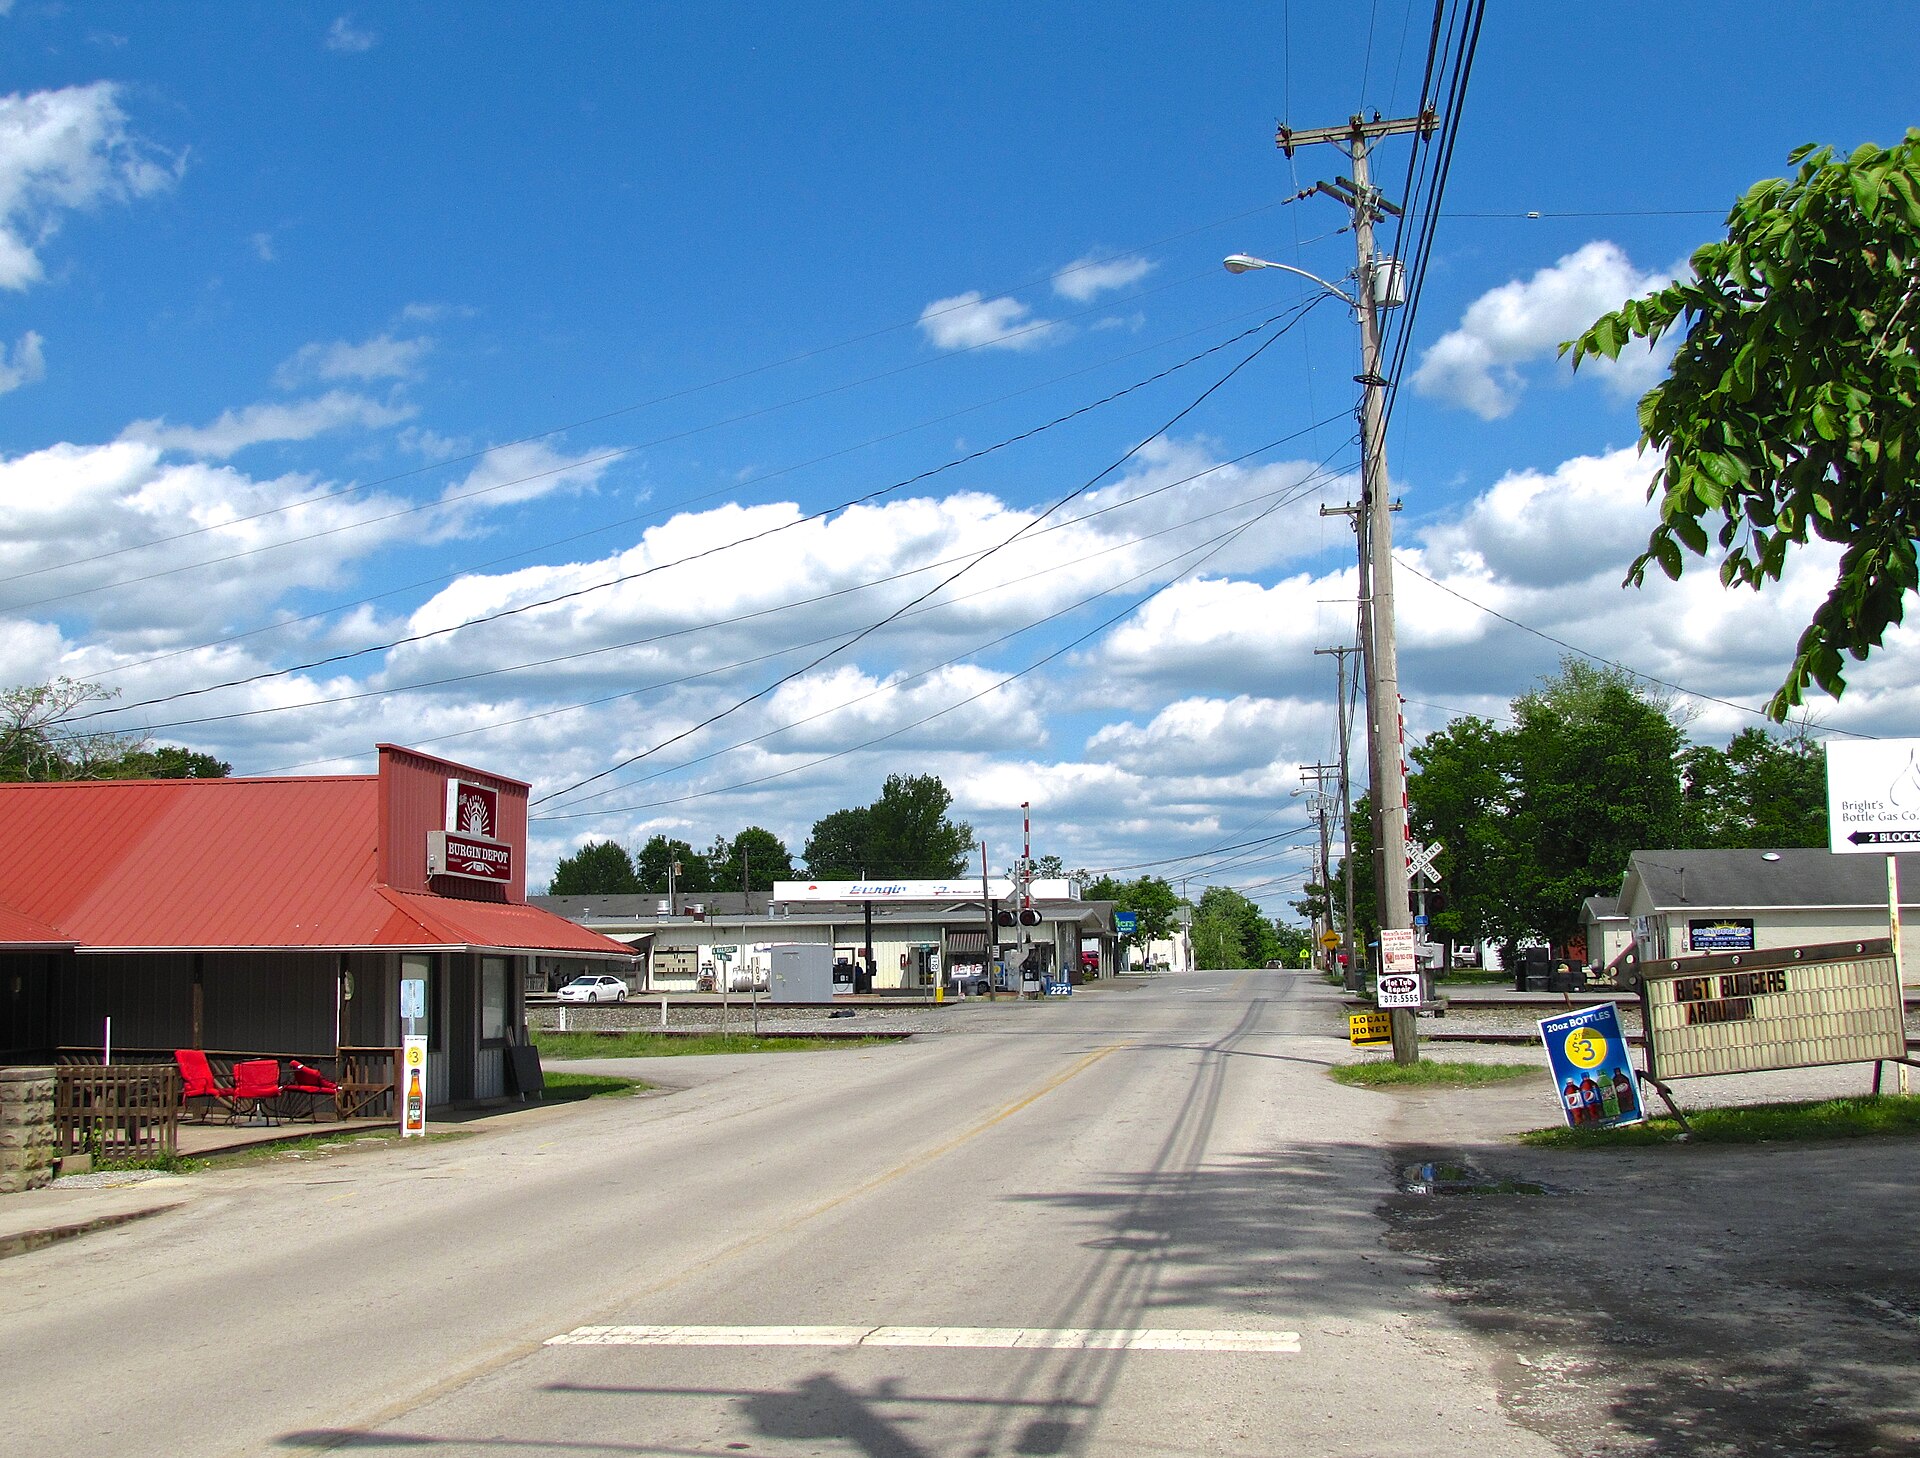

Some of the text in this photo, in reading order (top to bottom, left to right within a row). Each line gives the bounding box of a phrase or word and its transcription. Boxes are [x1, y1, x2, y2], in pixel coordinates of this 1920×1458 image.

[1842, 800, 1884, 813] Bright's
[1842, 811, 1919, 822] Bottle Gas Co.
[1868, 833, 1877, 842] 2
[448, 842, 509, 864] BURGIN DEPOT
[1405, 843, 1441, 877] ROSSING
[1385, 979, 1397, 987] Hot
[1676, 969, 1787, 1002] BST BUGERS
[1387, 986, 1411, 995] Repair
[1353, 1014, 1388, 1024] LOCAL
[1547, 1010, 1611, 1033] 20oz BOTTLES
[1352, 1025, 1389, 1035] HONEY
